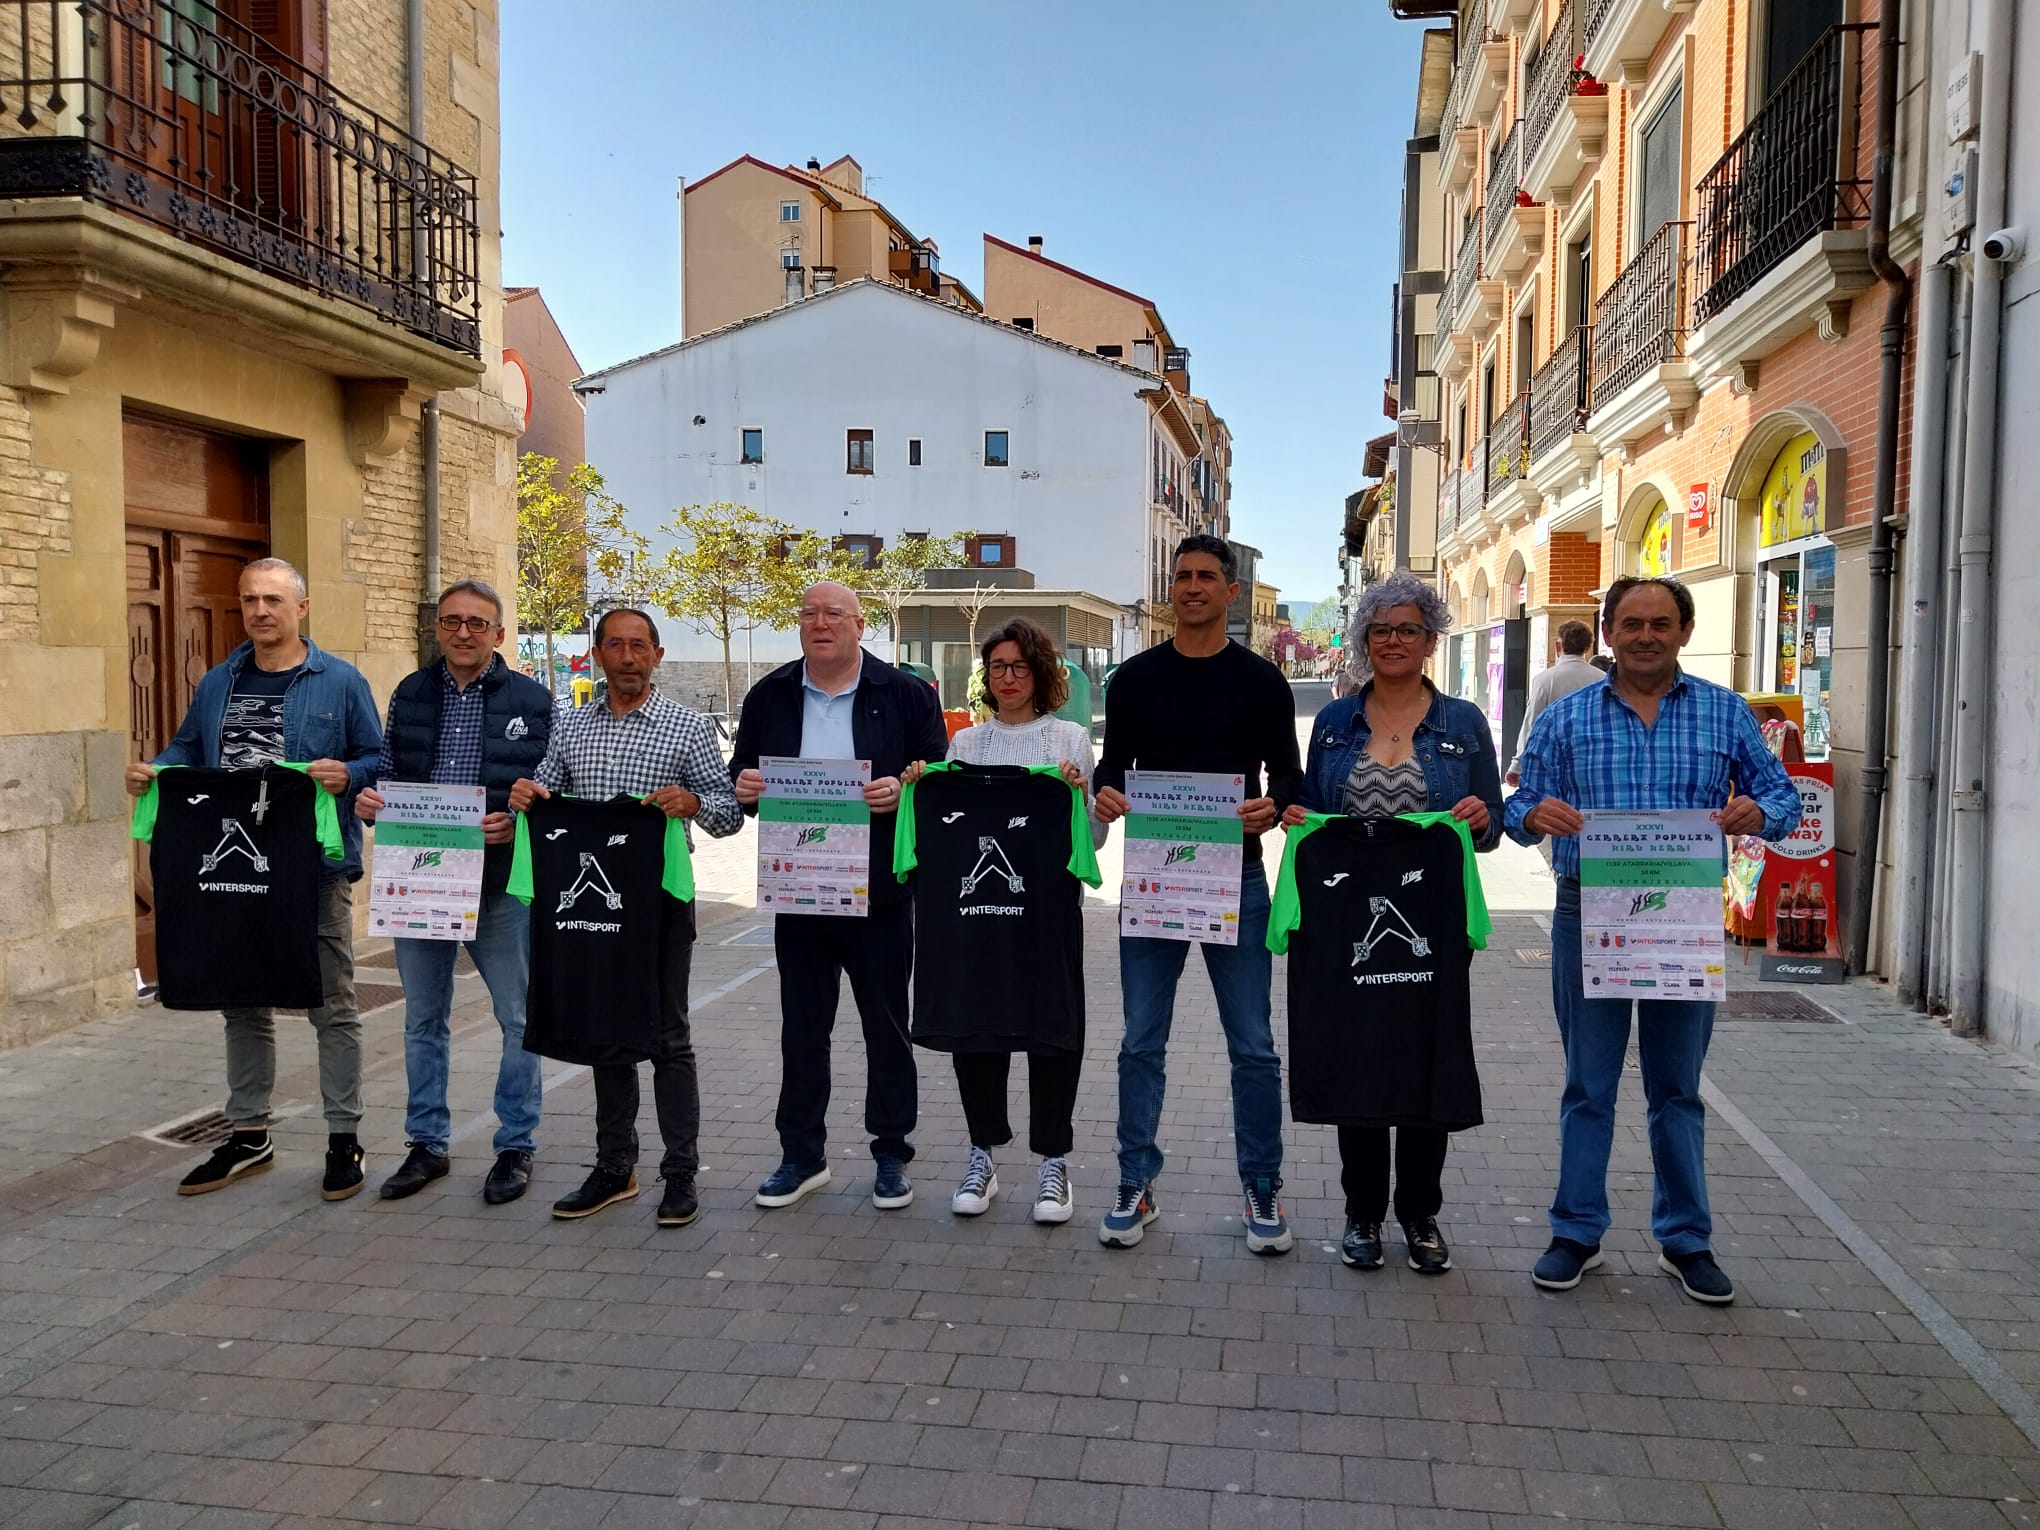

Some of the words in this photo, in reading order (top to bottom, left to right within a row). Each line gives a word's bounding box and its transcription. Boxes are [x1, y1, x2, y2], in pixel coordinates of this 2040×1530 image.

[764, 777, 813, 786] CARRERA
[1131, 792, 1182, 800] CARRERA
[1187, 794, 1237, 803] POPULAR
[1801, 792, 1817, 801] ra
[434, 804, 480, 813] POPULAR
[1800, 816, 1821, 828] ke
[1788, 830, 1823, 842] way
[1772, 842, 1794, 855] COLD
[1796, 843, 1826, 856] DRINKS
[209, 882, 269, 894] INTERSPORT
[969, 905, 1025, 916] INTERSPORT
[567, 920, 622, 932] INTESPORT
[1365, 971, 1434, 984] INTERSPORT
